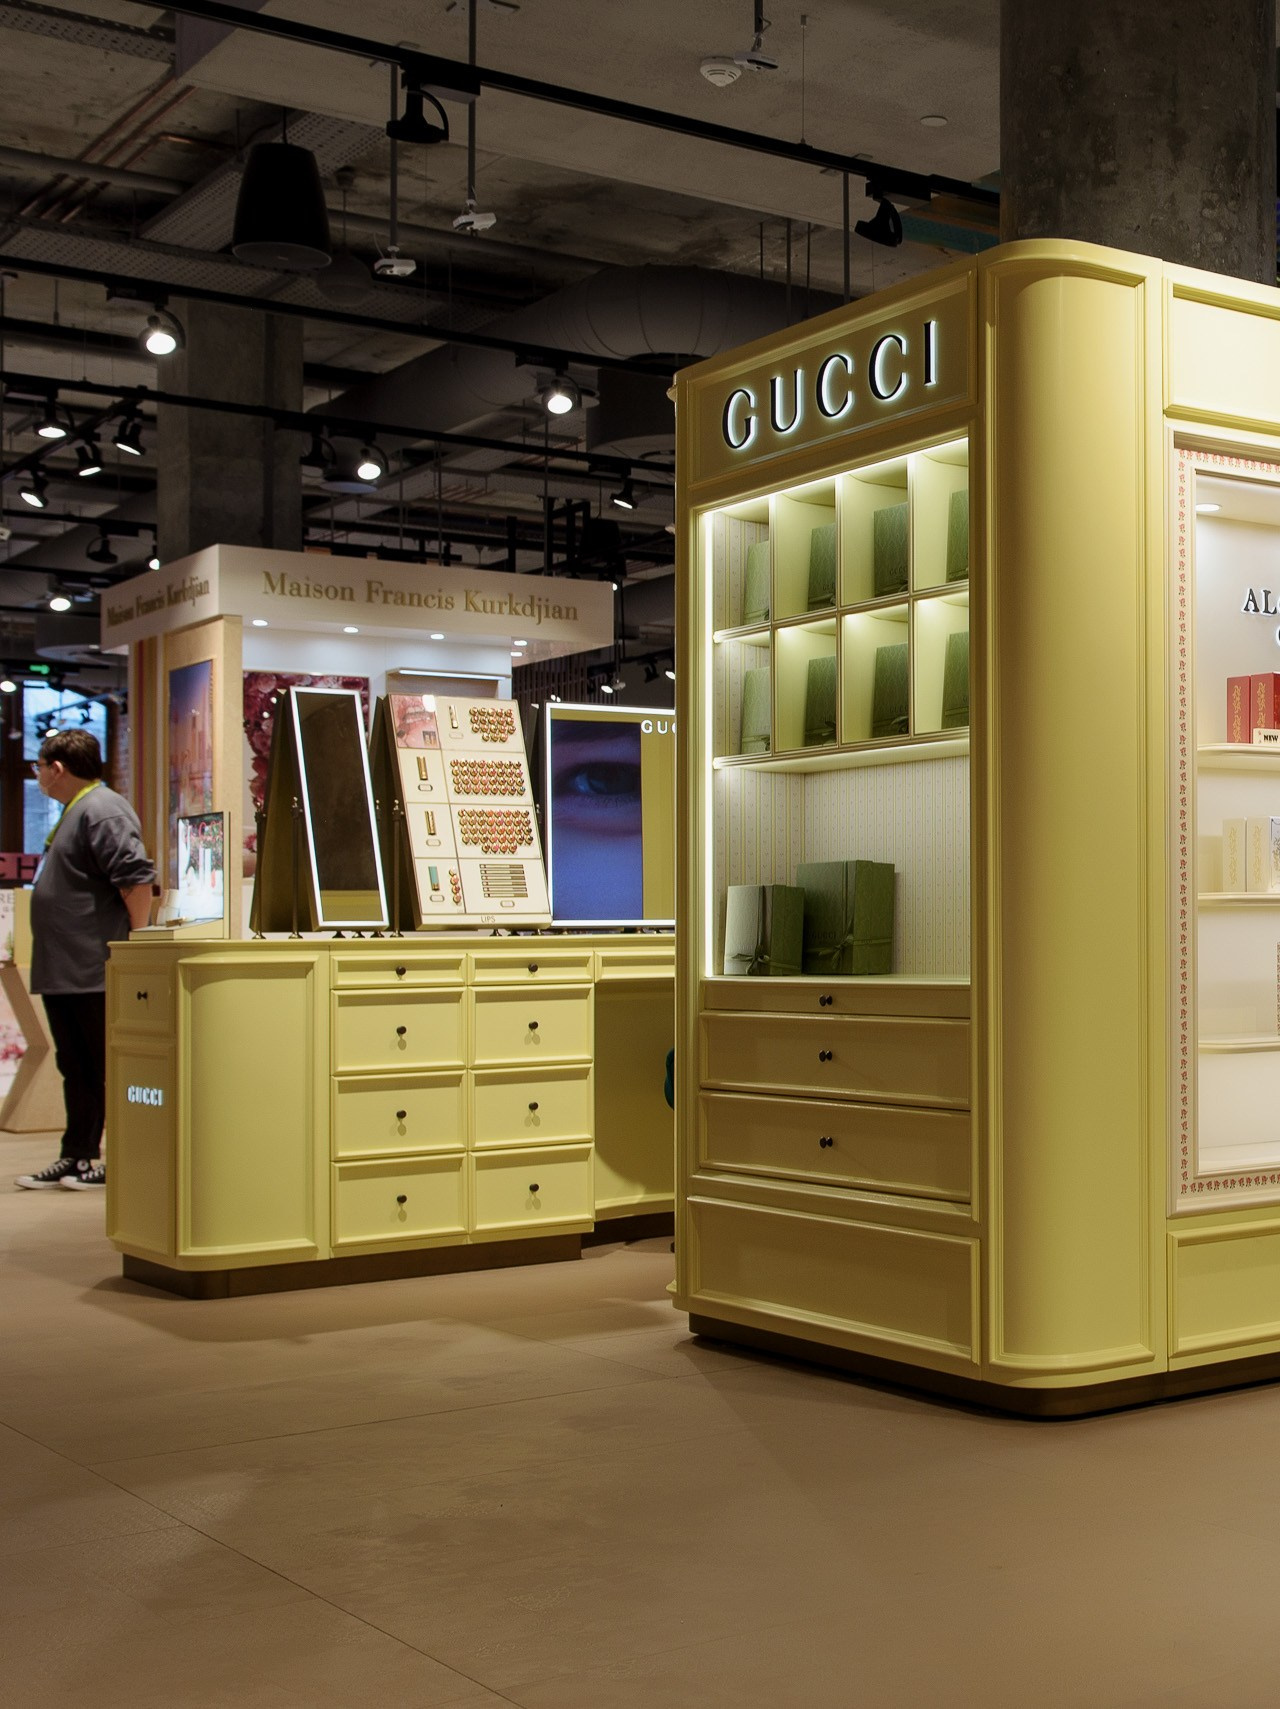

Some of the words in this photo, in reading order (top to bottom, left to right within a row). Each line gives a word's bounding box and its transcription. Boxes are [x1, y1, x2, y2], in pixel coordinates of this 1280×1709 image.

[722, 320, 938, 450] GUCCI
[262, 571, 355, 601] Maison
[366, 580, 454, 610] Francis
[464, 589, 578, 625] Kurkdjian
[1264, 734, 1278, 743] NEW
[481, 915, 496, 924] LIPS
[127, 1085, 163, 1106] GUCCI
